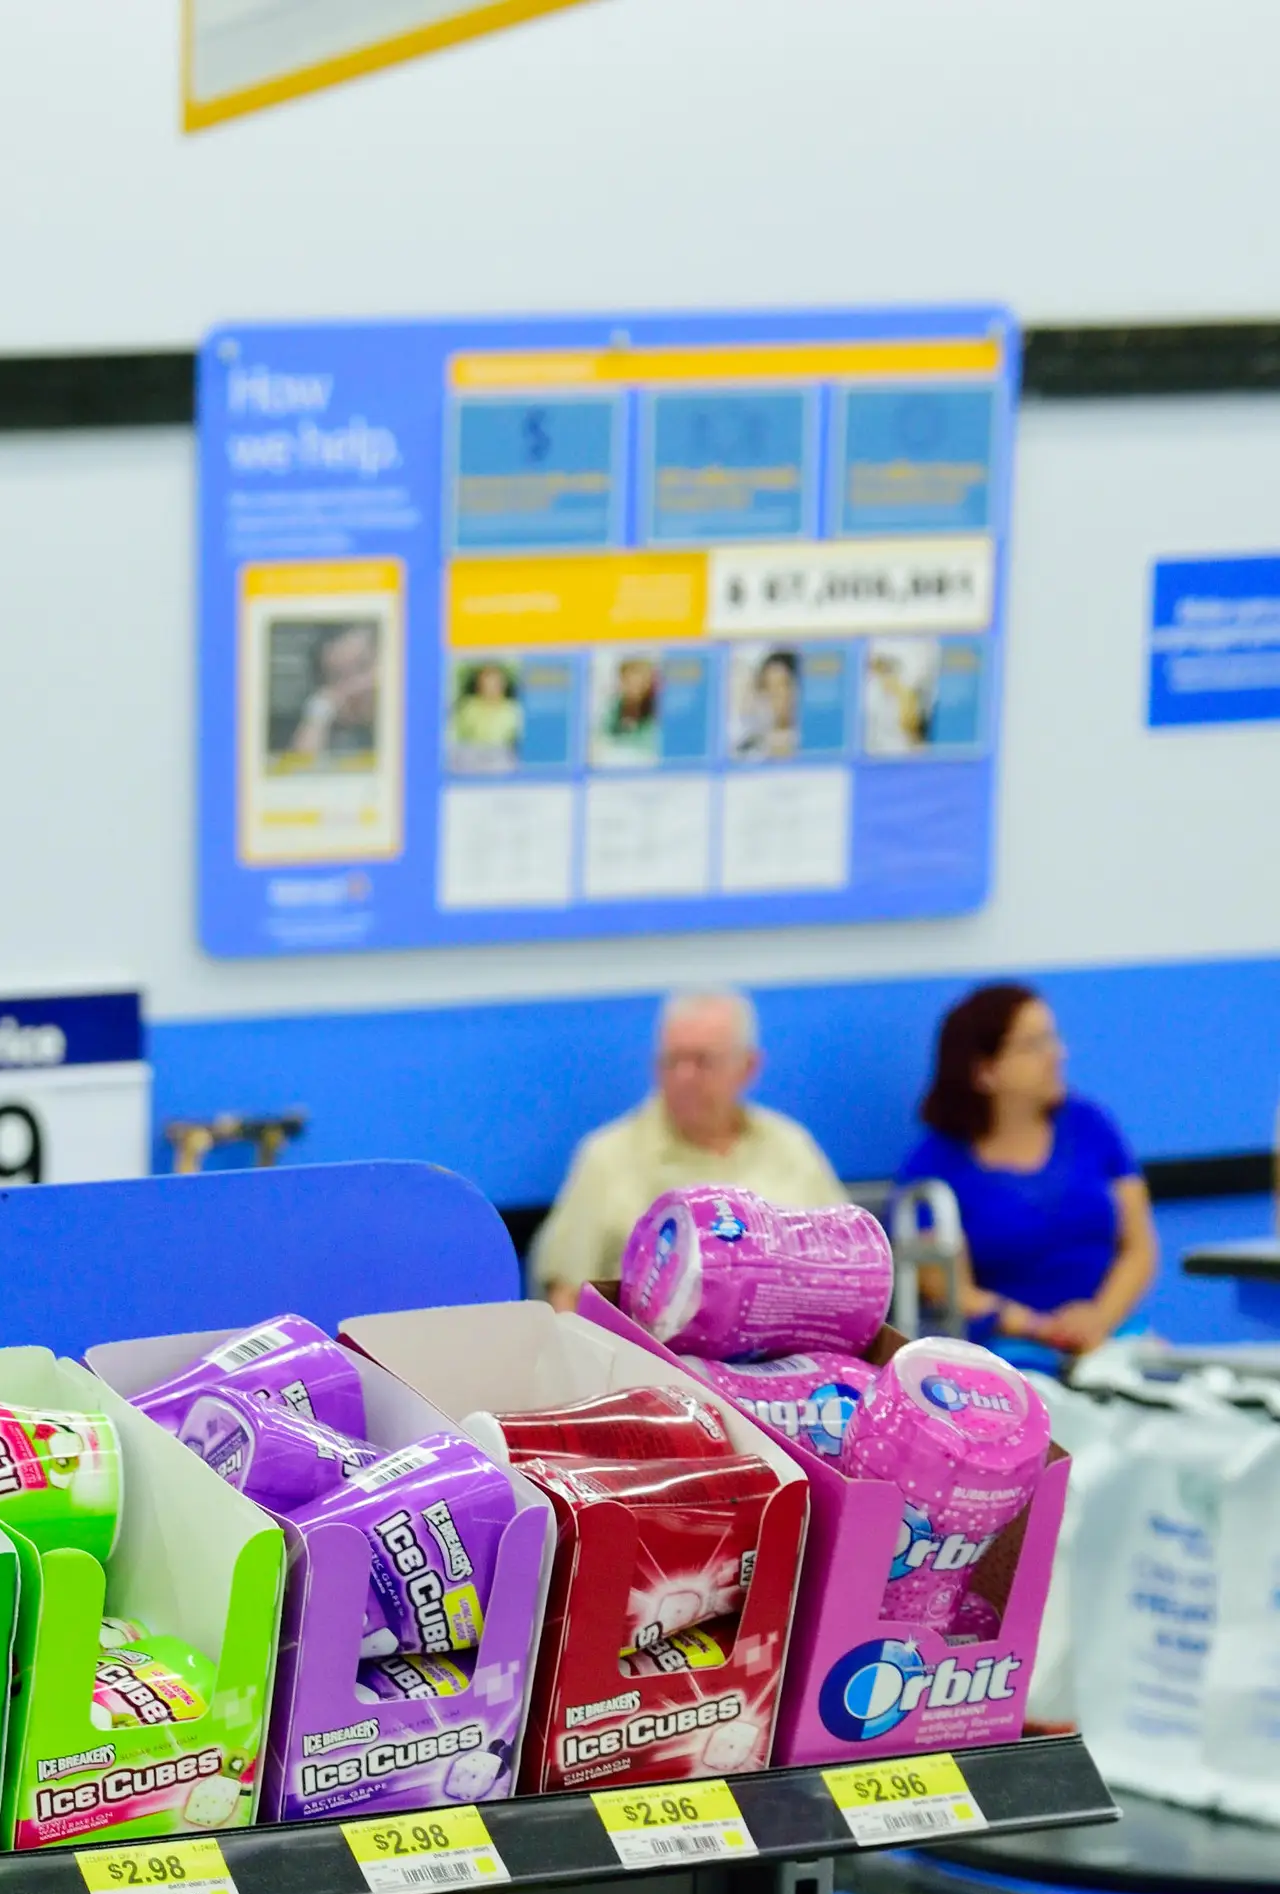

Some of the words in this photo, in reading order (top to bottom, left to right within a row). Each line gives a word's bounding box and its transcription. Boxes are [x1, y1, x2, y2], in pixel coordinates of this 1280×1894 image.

[819, 1638, 1023, 1743] Orbit
[853, 1772, 929, 1799] $2.96
[623, 1797, 699, 1825] $2.96
[373, 1823, 451, 1854] $2.98
[107, 1855, 187, 1885] $2.98
